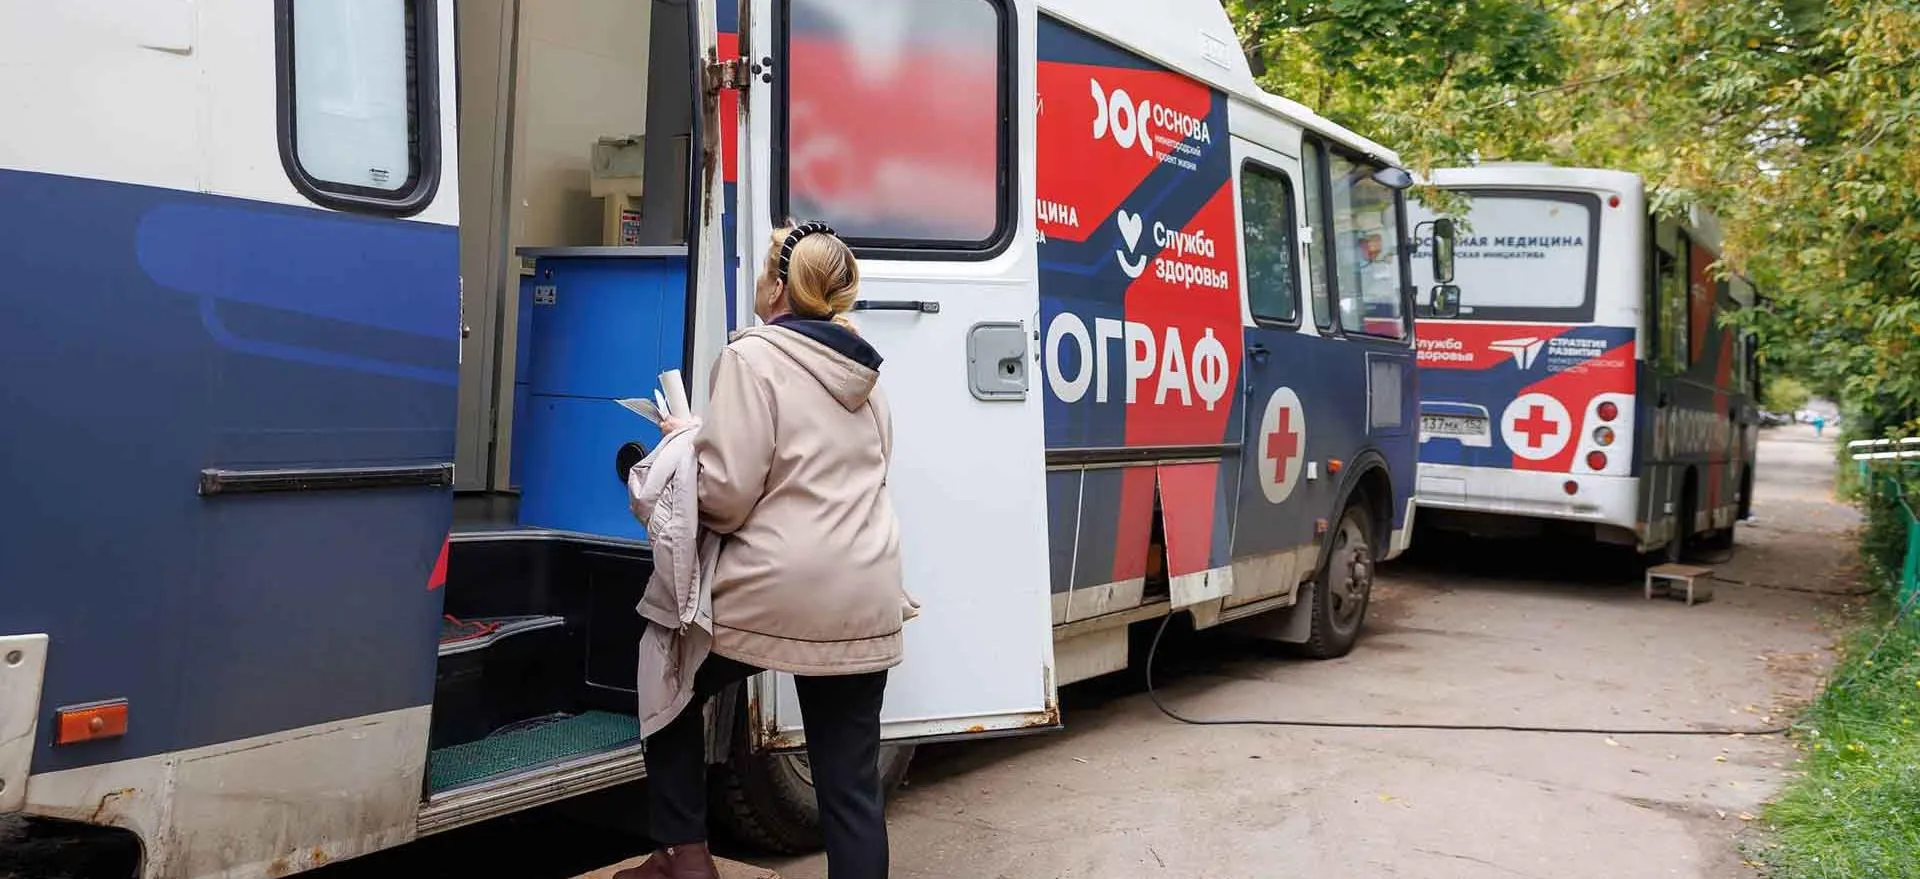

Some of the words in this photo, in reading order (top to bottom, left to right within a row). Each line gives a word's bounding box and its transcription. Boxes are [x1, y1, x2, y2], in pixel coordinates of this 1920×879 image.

[1153, 103, 1211, 145] ОСНОВА
[1037, 198, 1079, 228] ЦИНА
[1153, 221, 1215, 258] Служба
[1493, 236, 1584, 249] МЕДИЦИНА
[1155, 257, 1229, 290] здоровья
[1416, 338, 1463, 350] лужба
[1045, 312, 1229, 412] ОГРАФ
